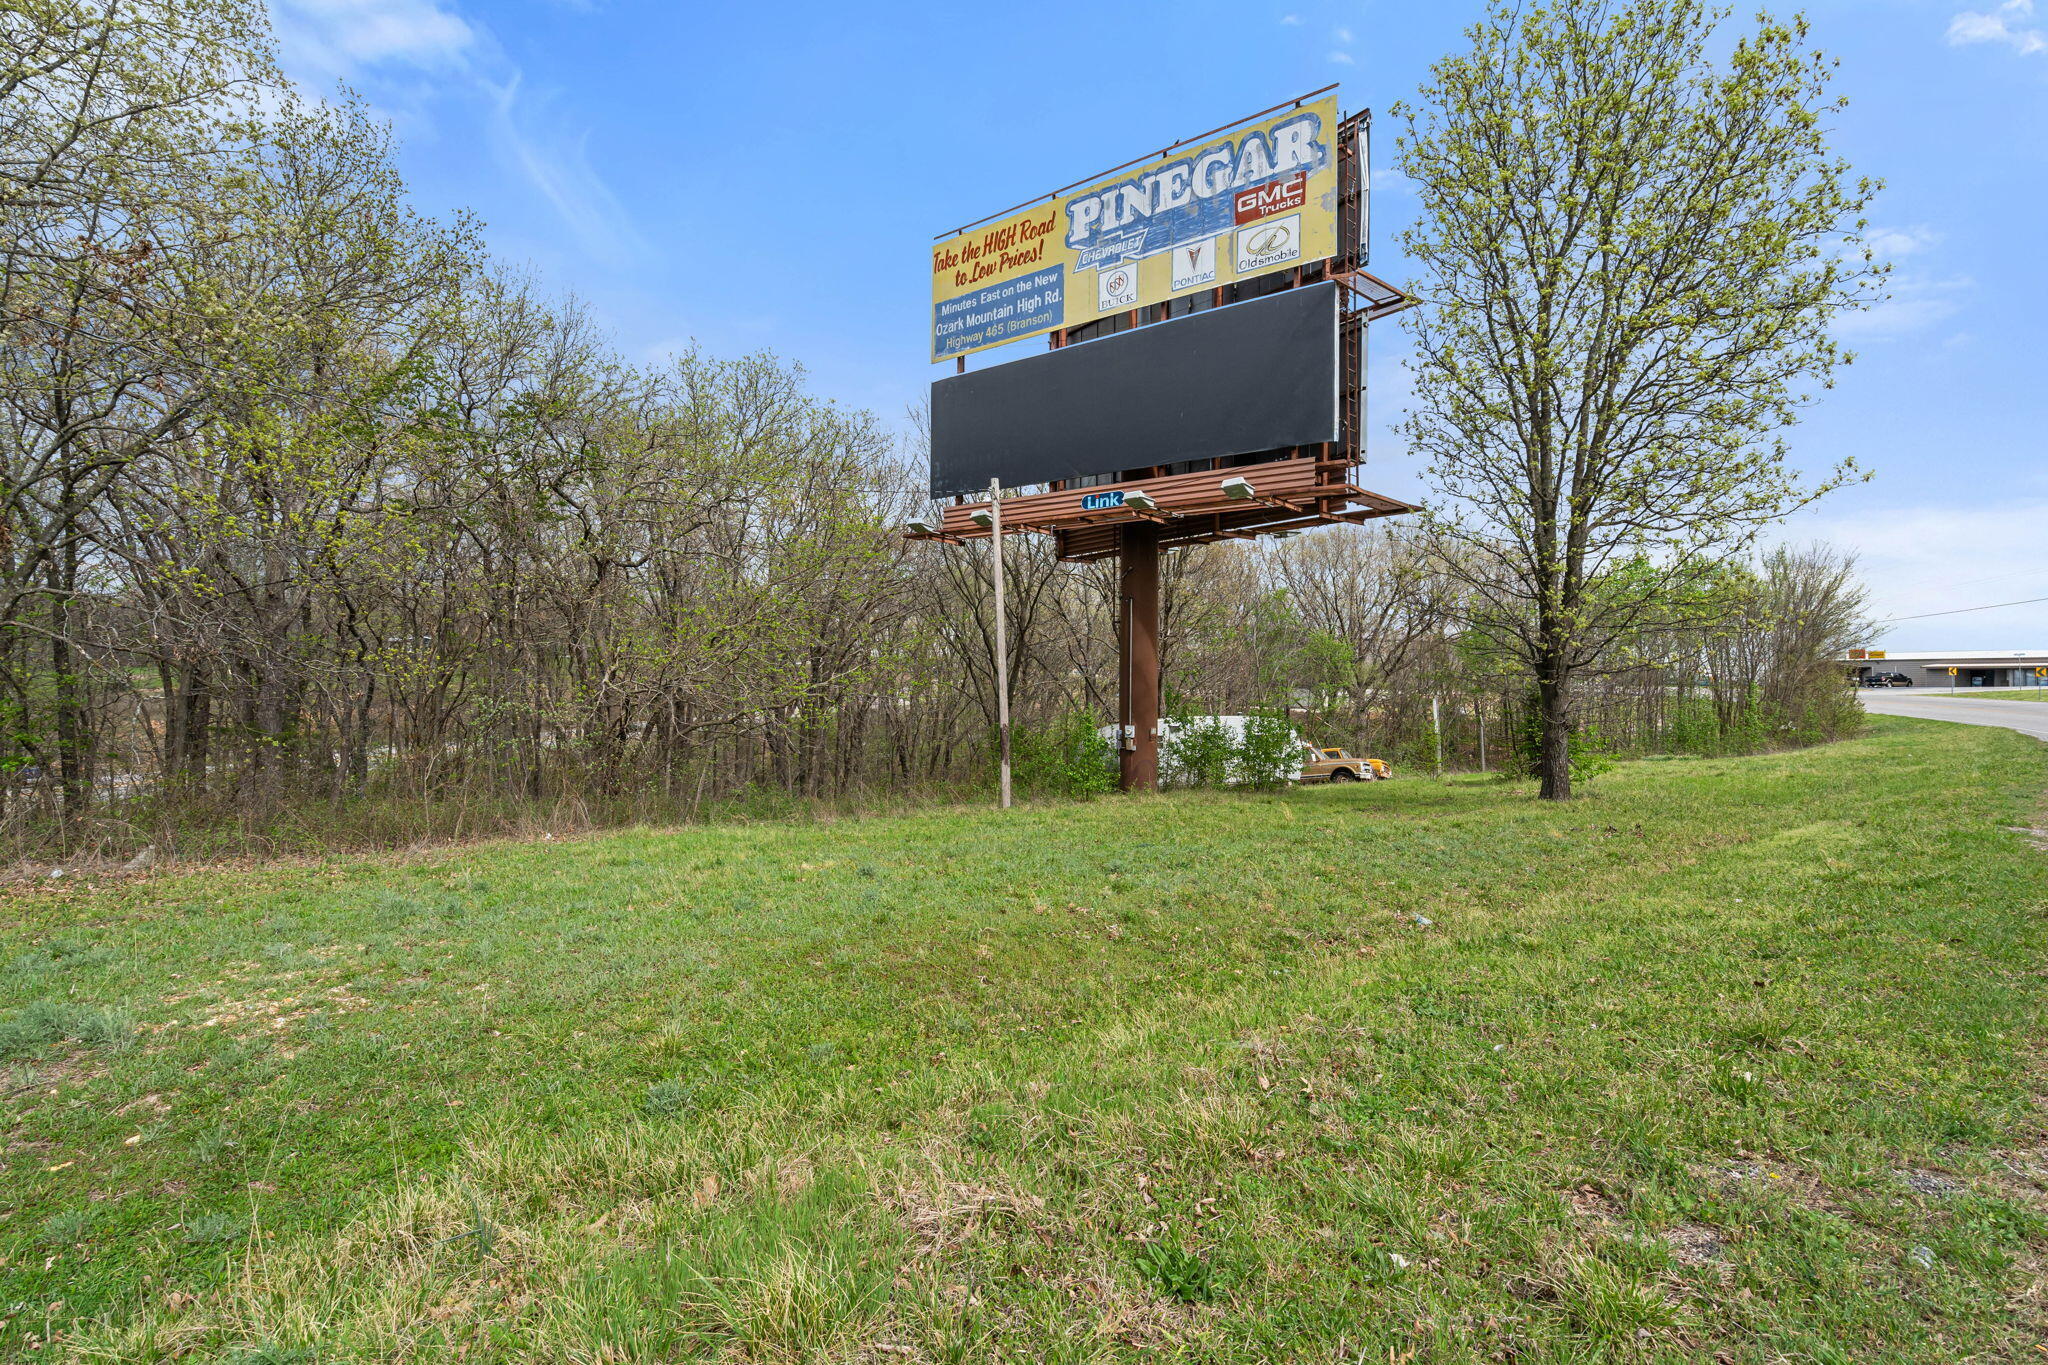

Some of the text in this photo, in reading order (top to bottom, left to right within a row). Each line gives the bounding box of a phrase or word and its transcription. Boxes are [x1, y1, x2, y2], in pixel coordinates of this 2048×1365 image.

[1068, 120, 1323, 242] PINEGAR
[1238, 178, 1303, 212] GMC
[1259, 196, 1301, 215] Trucks
[934, 210, 1056, 274] Take the HIGH Road
[1082, 236, 1143, 265] CHEVROLET
[1239, 248, 1298, 270] Oldsmobile
[955, 239, 1045, 287] to Low Prices!
[1174, 270, 1215, 288] PONTIAC
[941, 273, 1058, 316] Minutes East on the New
[1101, 293, 1133, 309] BUICK
[936, 288, 1063, 336] Ozark Mountain High Rd.
[946, 310, 1053, 349] Highway 465 (Branson)
[1087, 493, 1120, 509] Link
